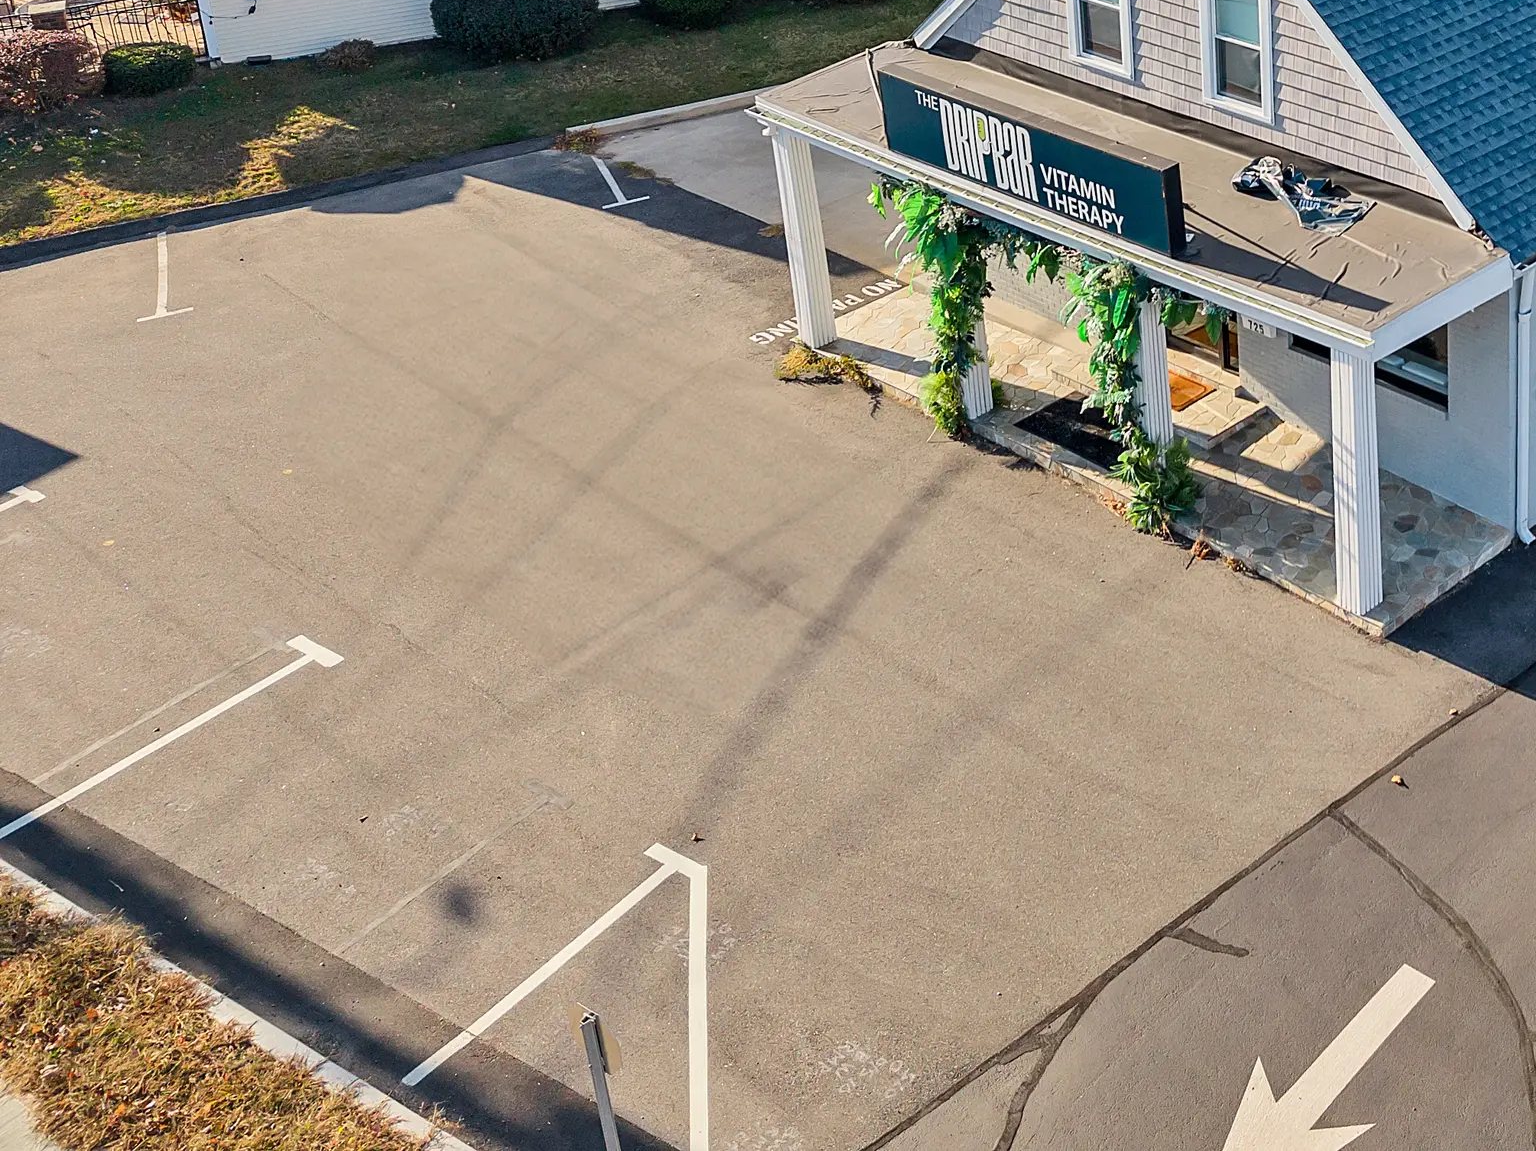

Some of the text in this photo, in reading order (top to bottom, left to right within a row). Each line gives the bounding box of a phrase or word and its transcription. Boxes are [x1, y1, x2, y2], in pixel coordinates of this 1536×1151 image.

[914, 89, 939, 112] THE
[1040, 163, 1116, 209] VITAMIN
[1042, 187, 1125, 235] THERAPY
[749, 278, 903, 345] NO PAING
[1247, 319, 1265, 335] 725
